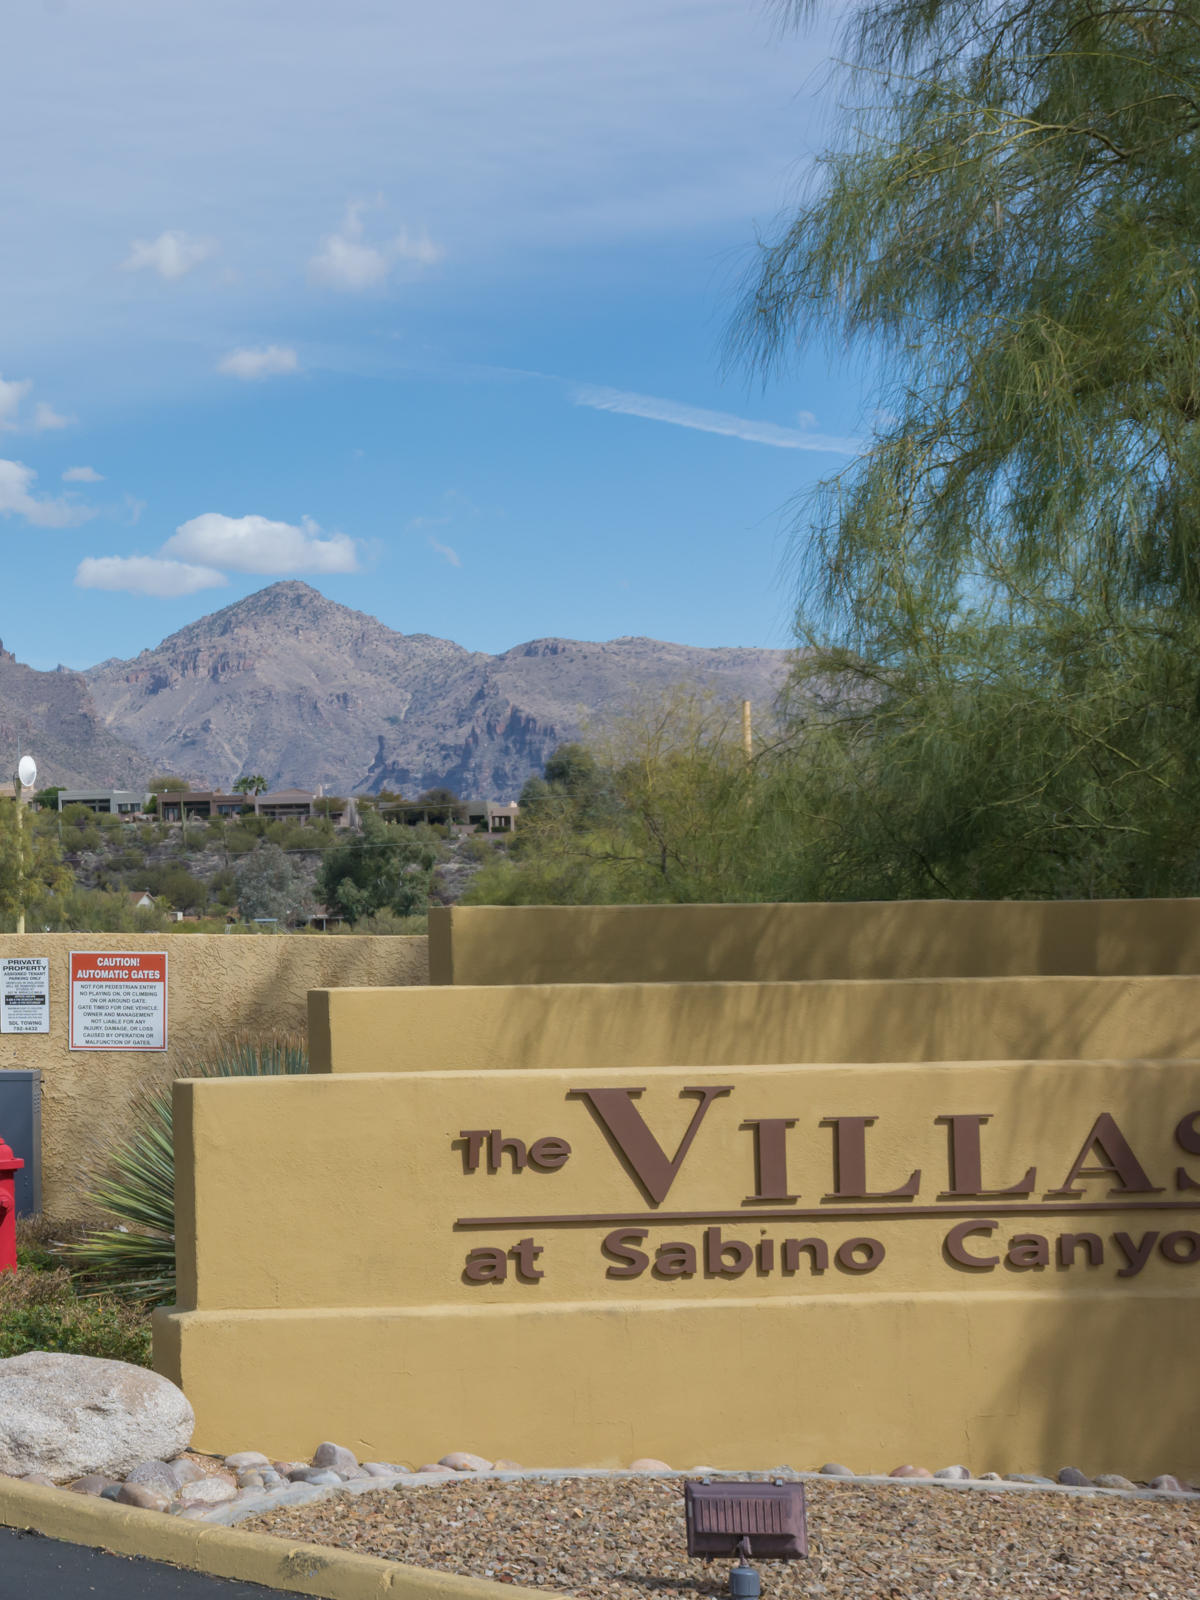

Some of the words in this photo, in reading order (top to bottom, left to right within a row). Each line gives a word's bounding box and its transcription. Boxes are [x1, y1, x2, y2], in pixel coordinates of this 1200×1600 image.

[96, 958, 140, 966] CAUTION!
[76, 970, 129, 978] AUTOMATIC
[131, 970, 160, 979] GATES
[459, 1129, 572, 1169] The
[465, 1237, 545, 1281] at
[603, 1226, 886, 1276] Sabino
